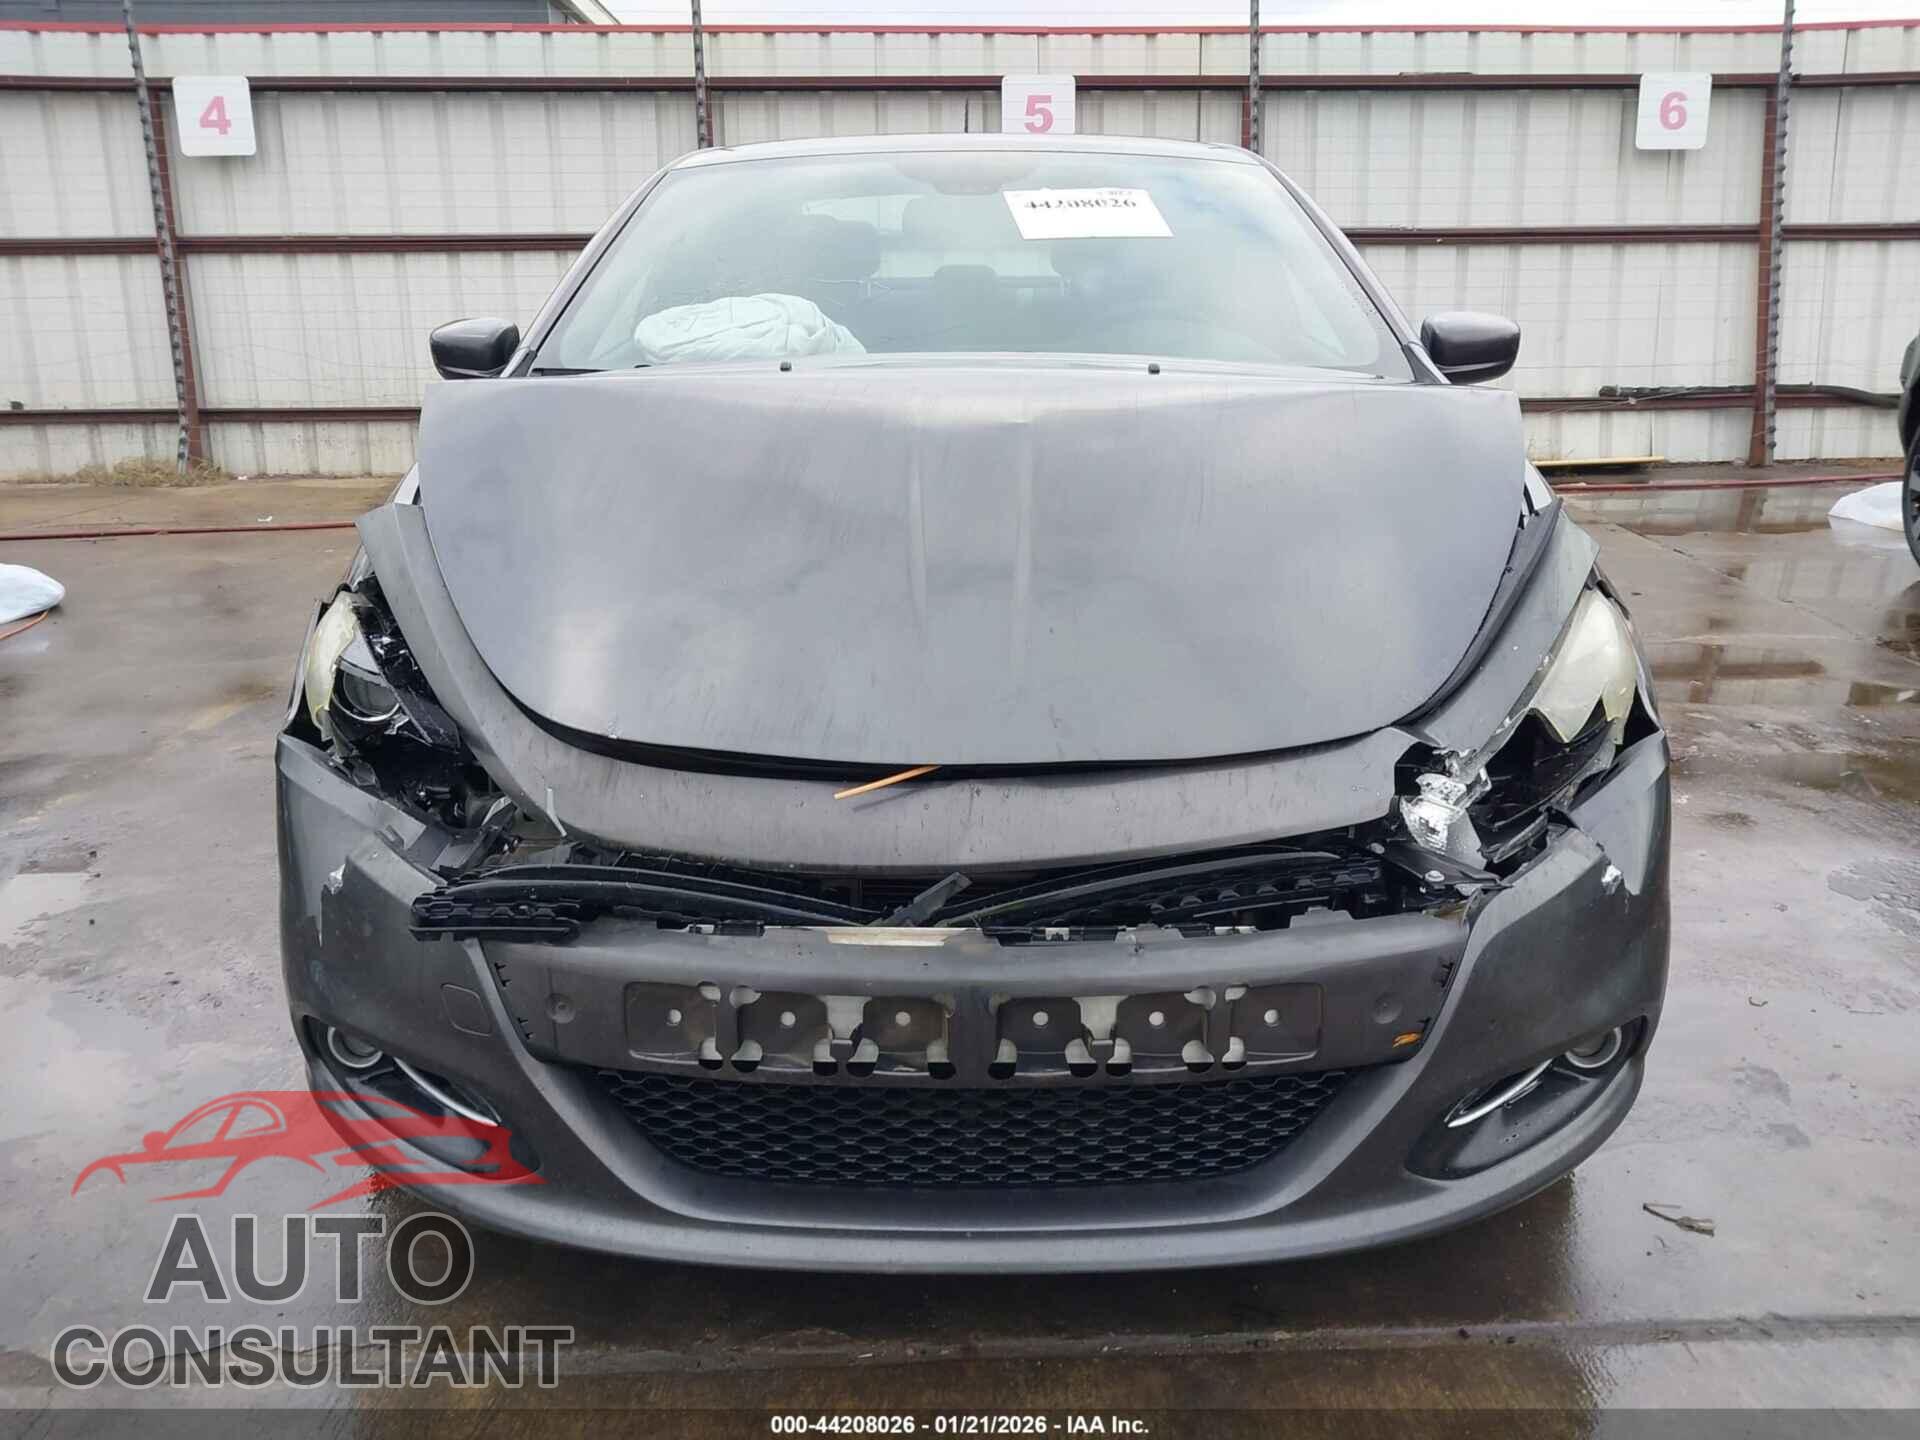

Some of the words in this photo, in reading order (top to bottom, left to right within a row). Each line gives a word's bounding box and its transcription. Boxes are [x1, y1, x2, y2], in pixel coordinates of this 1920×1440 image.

[200, 96, 231, 135] 4
[1024, 95, 1053, 134] 5
[1660, 91, 1688, 130] 6
